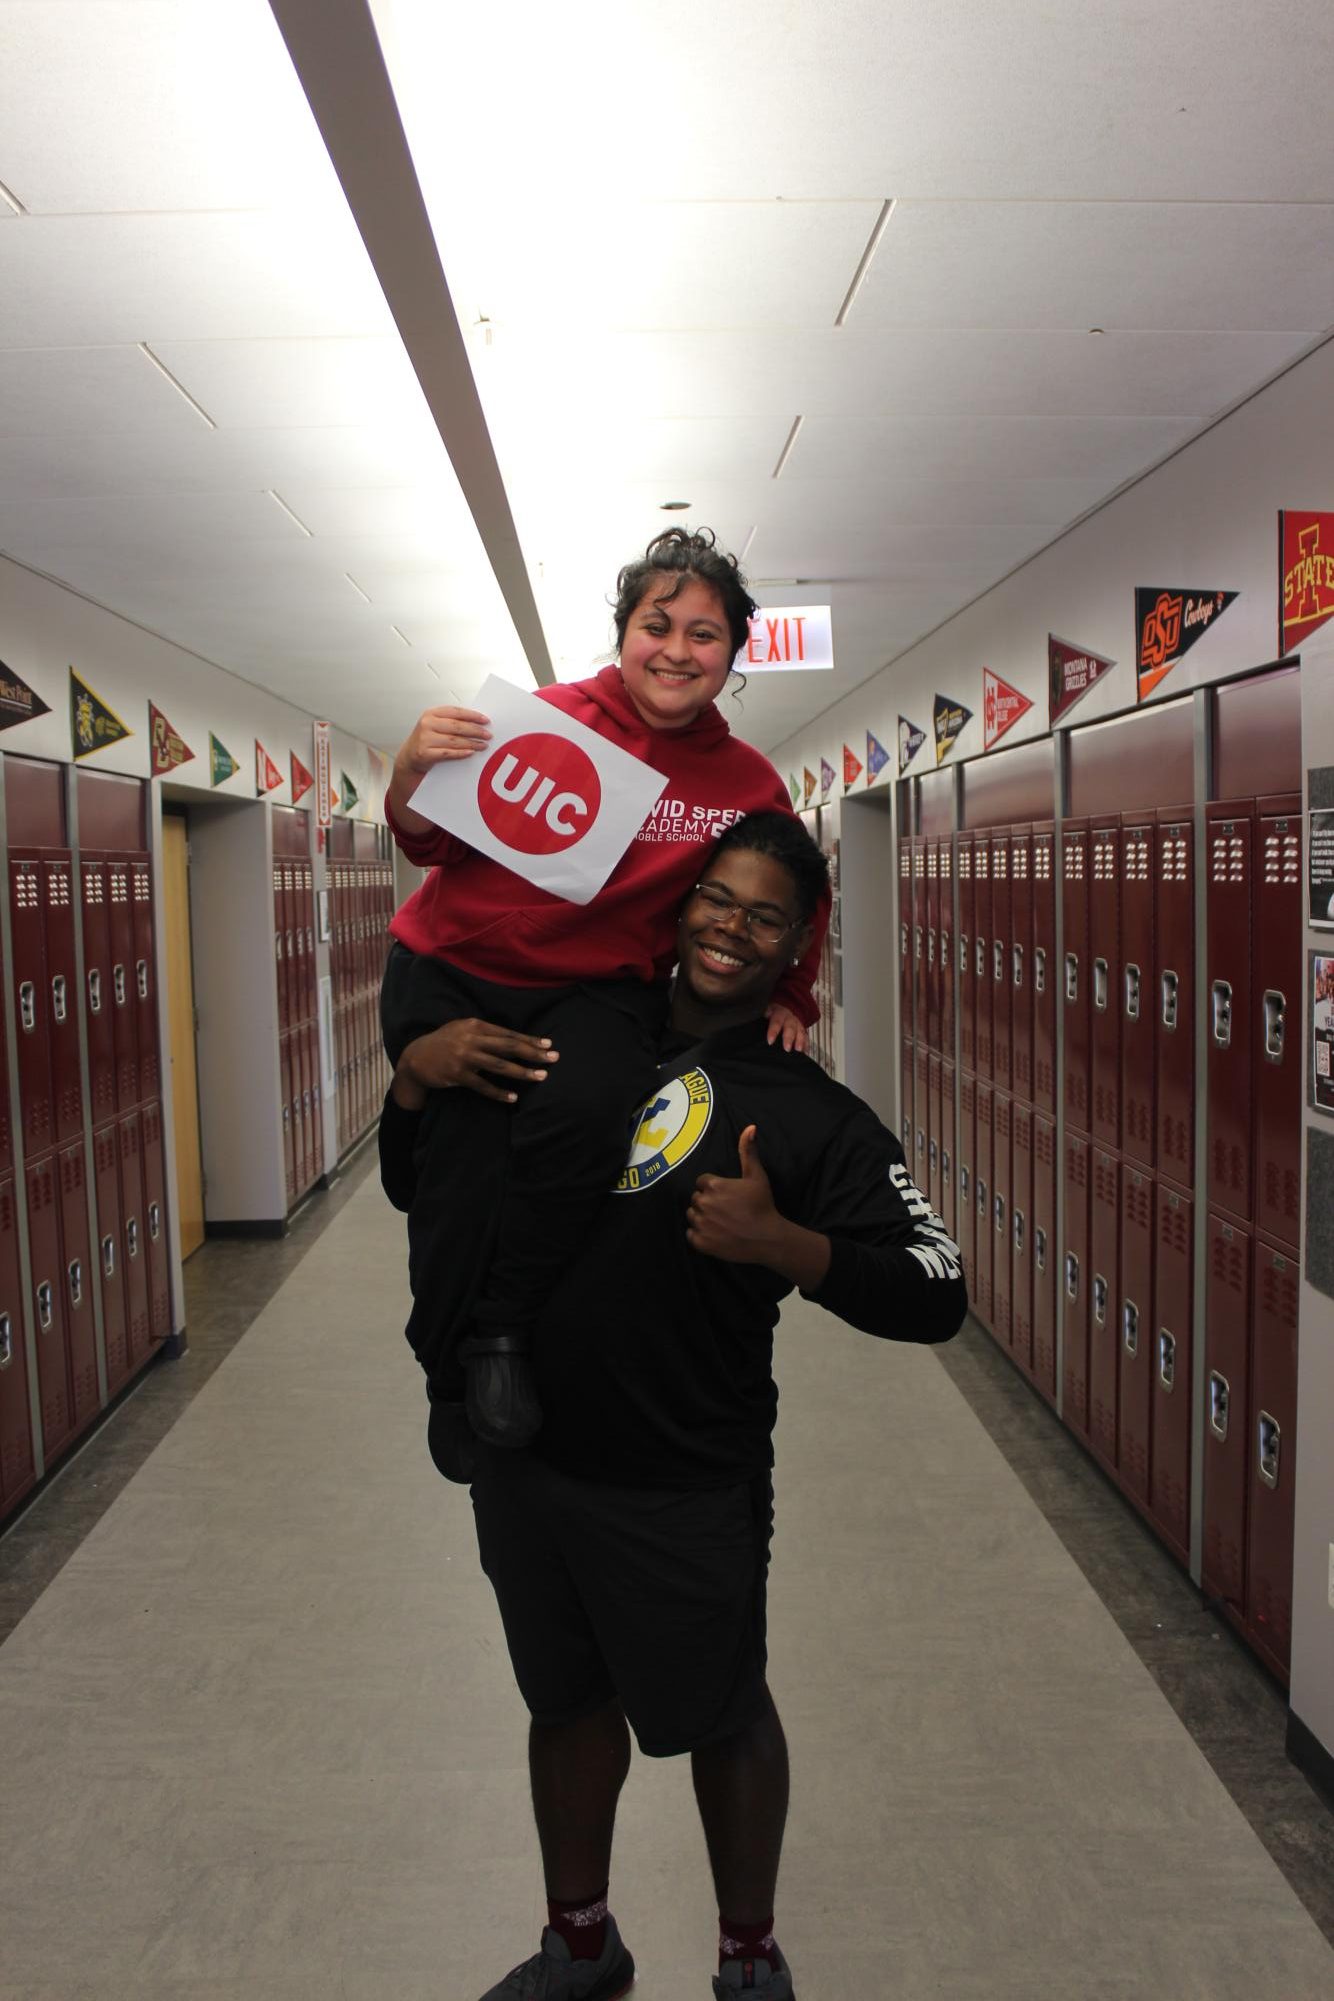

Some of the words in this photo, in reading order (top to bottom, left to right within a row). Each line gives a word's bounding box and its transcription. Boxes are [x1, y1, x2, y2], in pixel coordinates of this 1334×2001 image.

[1284, 554, 1334, 608] STATE
[1184, 597, 1214, 628] Cowboys
[746, 617, 806, 663] EXIT
[1141, 592, 1183, 669] OSU
[1064, 658, 1088, 676] MONTANA
[1065, 673, 1087, 691] GRIZZLIES
[490, 753, 588, 836] UIC
[650, 799, 685, 818] VID
[636, 832, 664, 842] OBLE
[666, 833, 705, 843] SCHOOL
[642, 818, 711, 834] ADEMY
[680, 1070, 710, 1105] AGUE
[644, 1161, 661, 1177] 2018
